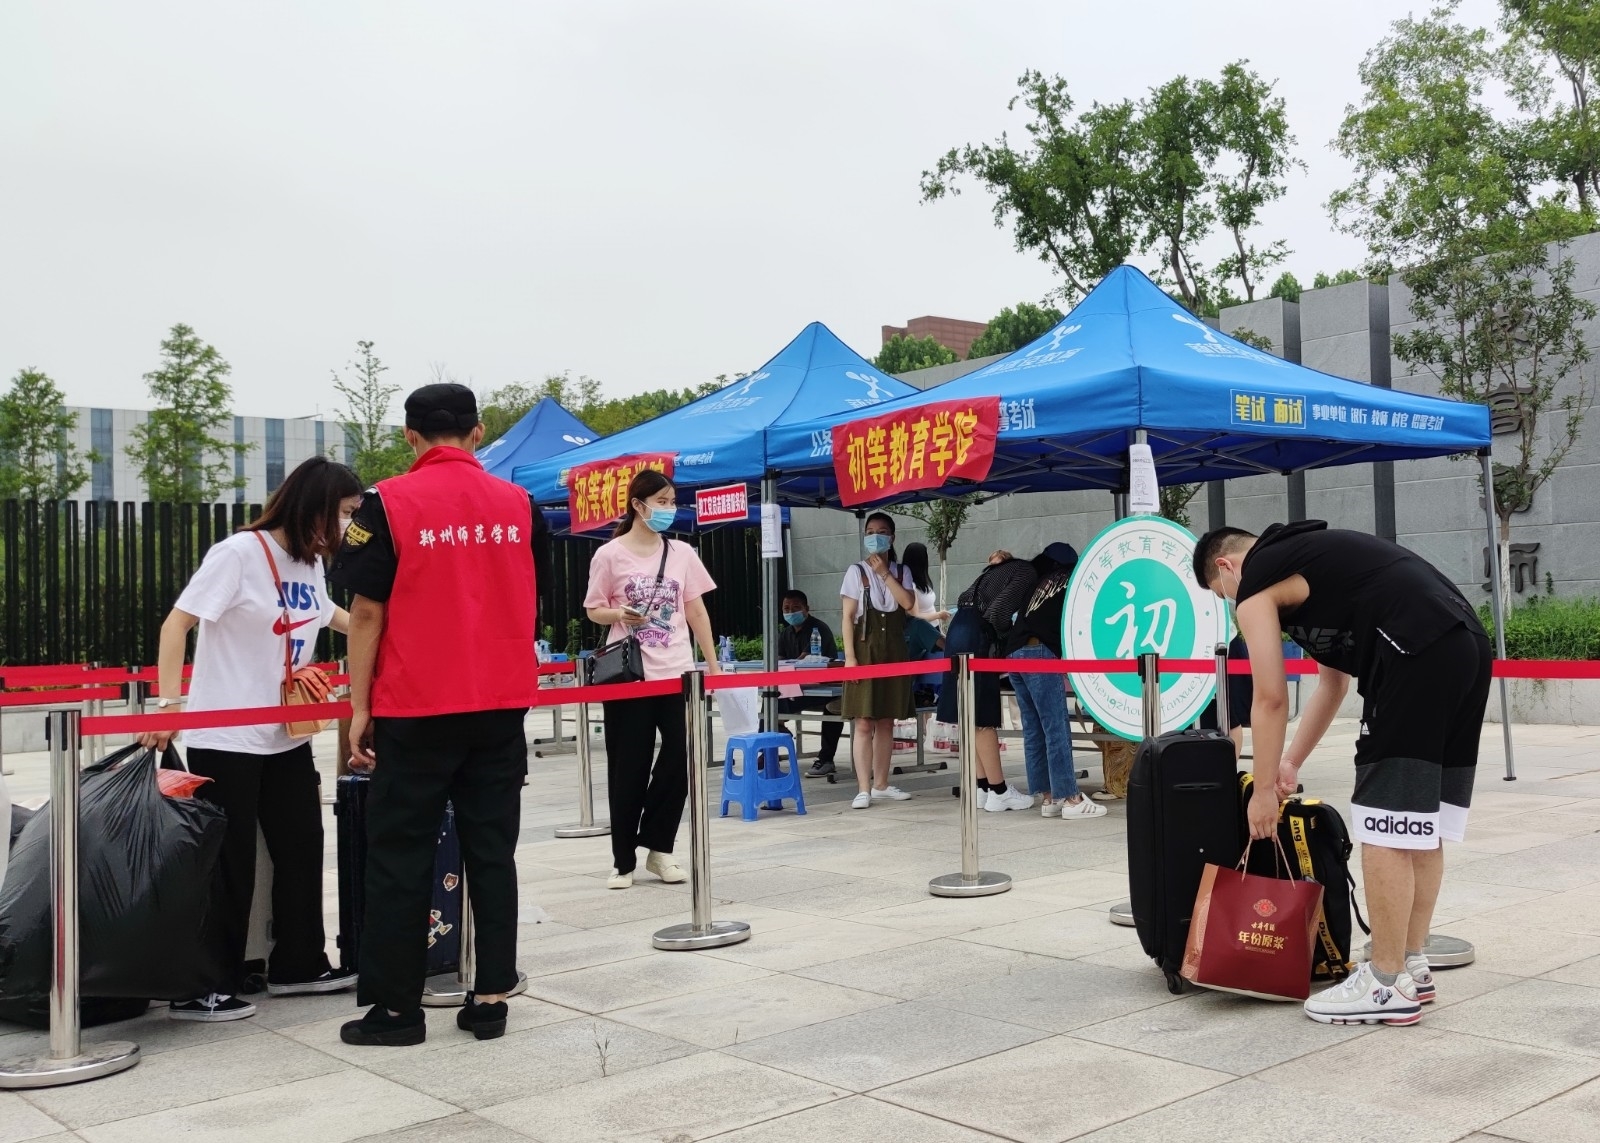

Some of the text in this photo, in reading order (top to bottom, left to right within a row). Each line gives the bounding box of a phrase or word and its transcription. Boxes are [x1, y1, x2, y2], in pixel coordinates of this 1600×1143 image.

[1235, 394, 1303, 425] 笔试 面试
[1312, 404, 1444, 431] 事业单位 银行 教师 村官 招警考试
[847, 407, 978, 494] 初等教育学院
[419, 524, 521, 549] 郑州师范学院
[1083, 535, 1195, 593] 初等教育学院
[1104, 581, 1178, 660] 初
[1364, 815, 1434, 836] adidas
[1238, 930, 1285, 950] 年份原浆
